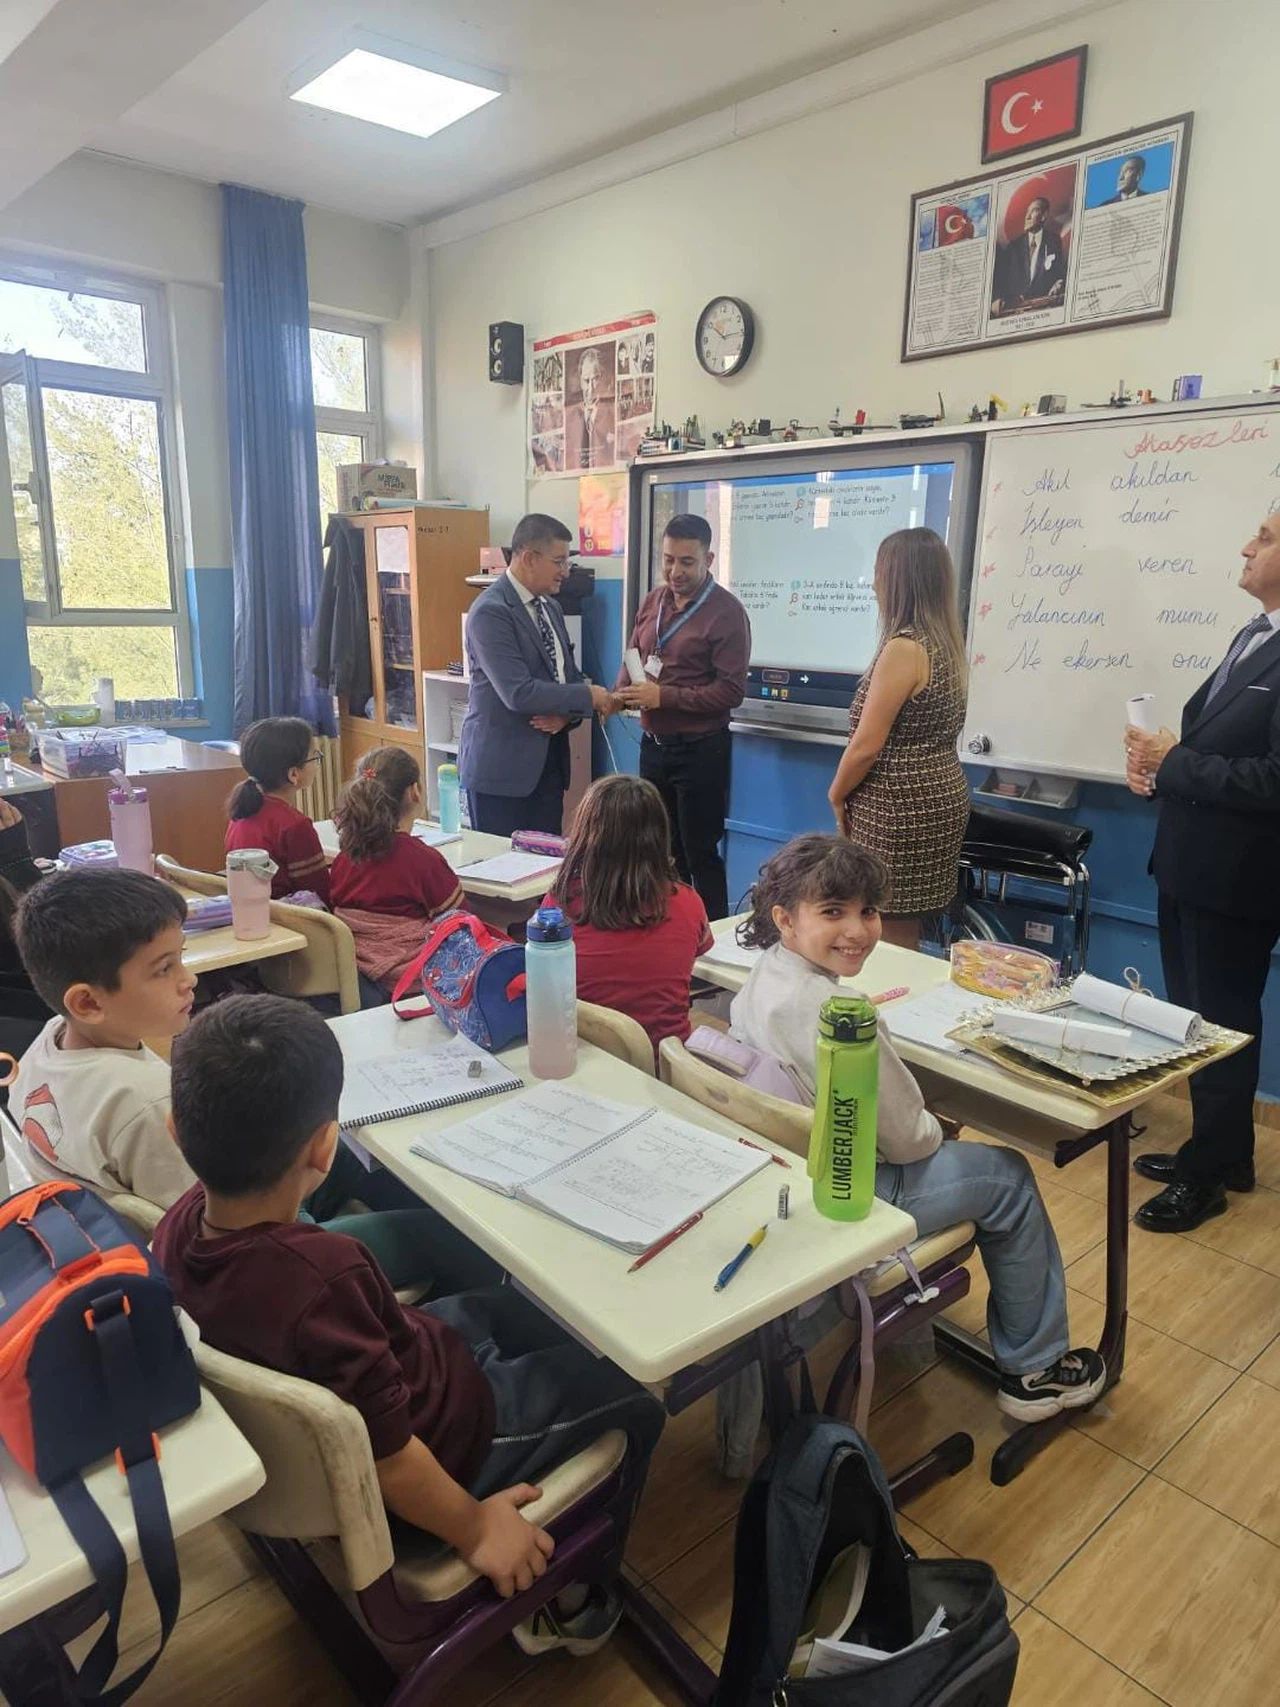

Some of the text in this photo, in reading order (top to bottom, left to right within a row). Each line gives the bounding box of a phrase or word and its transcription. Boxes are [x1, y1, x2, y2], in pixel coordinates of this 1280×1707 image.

[1119, 498, 1180, 524] demir
[1004, 639, 1043, 673] Ne
[1171, 652, 1212, 670] onu
[832, 1097, 854, 1200] LUMBERJACK
